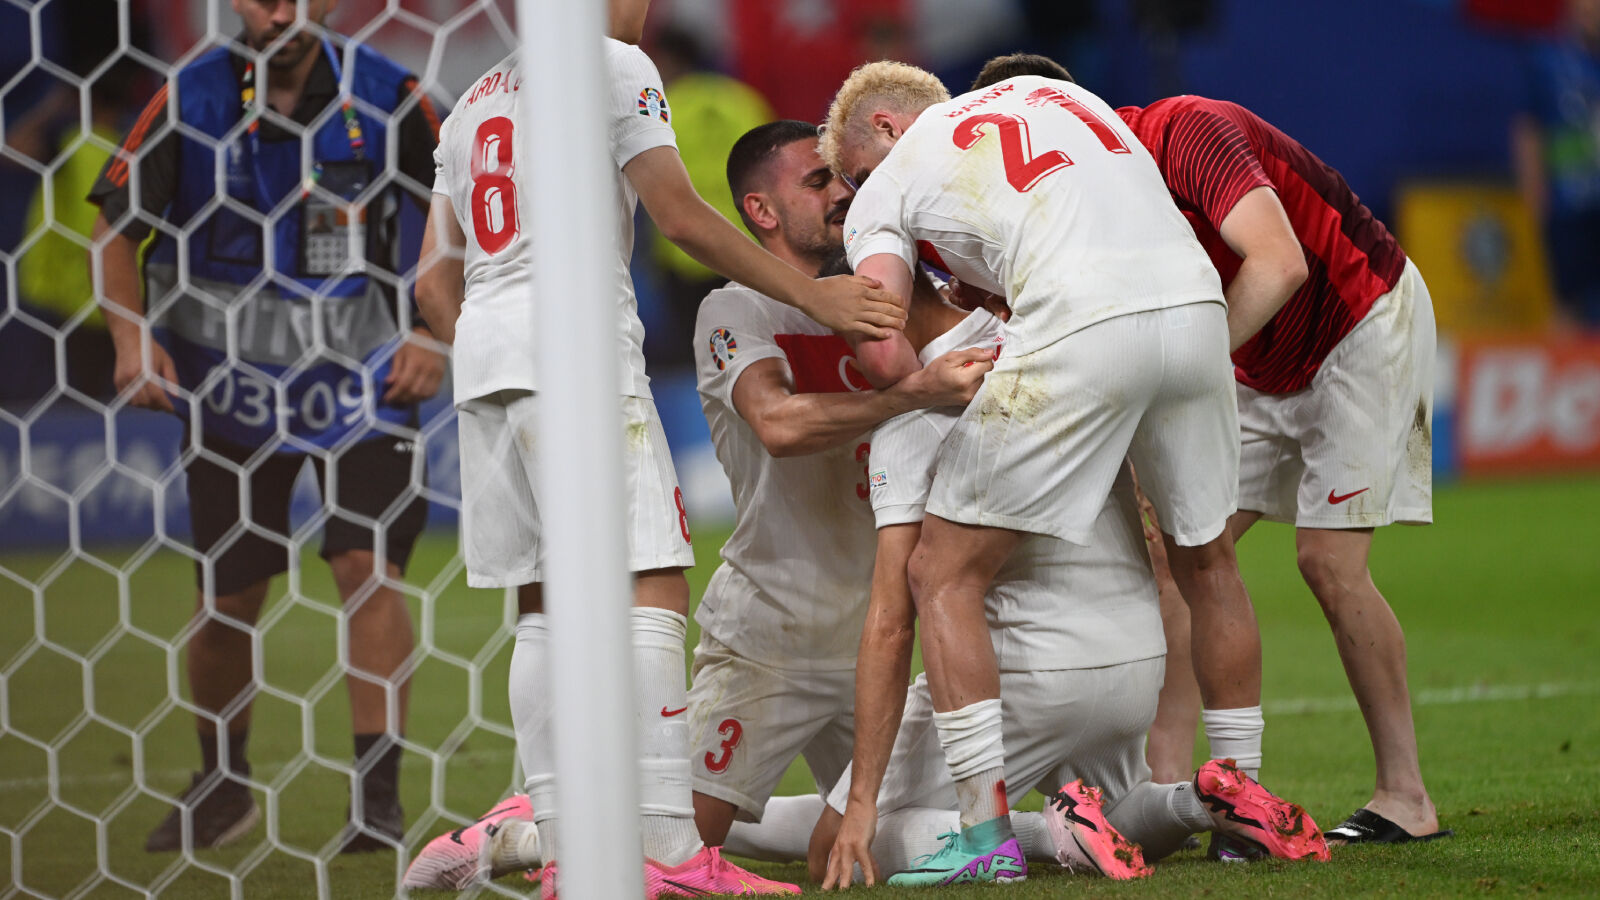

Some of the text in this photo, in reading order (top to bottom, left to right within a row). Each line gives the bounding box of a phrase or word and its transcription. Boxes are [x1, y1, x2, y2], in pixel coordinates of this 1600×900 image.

[464, 69, 513, 110] ARDA
[952, 86, 1132, 193] 21
[470, 116, 521, 257] 8
[674, 486, 691, 546] 8
[704, 718, 743, 774] 3
